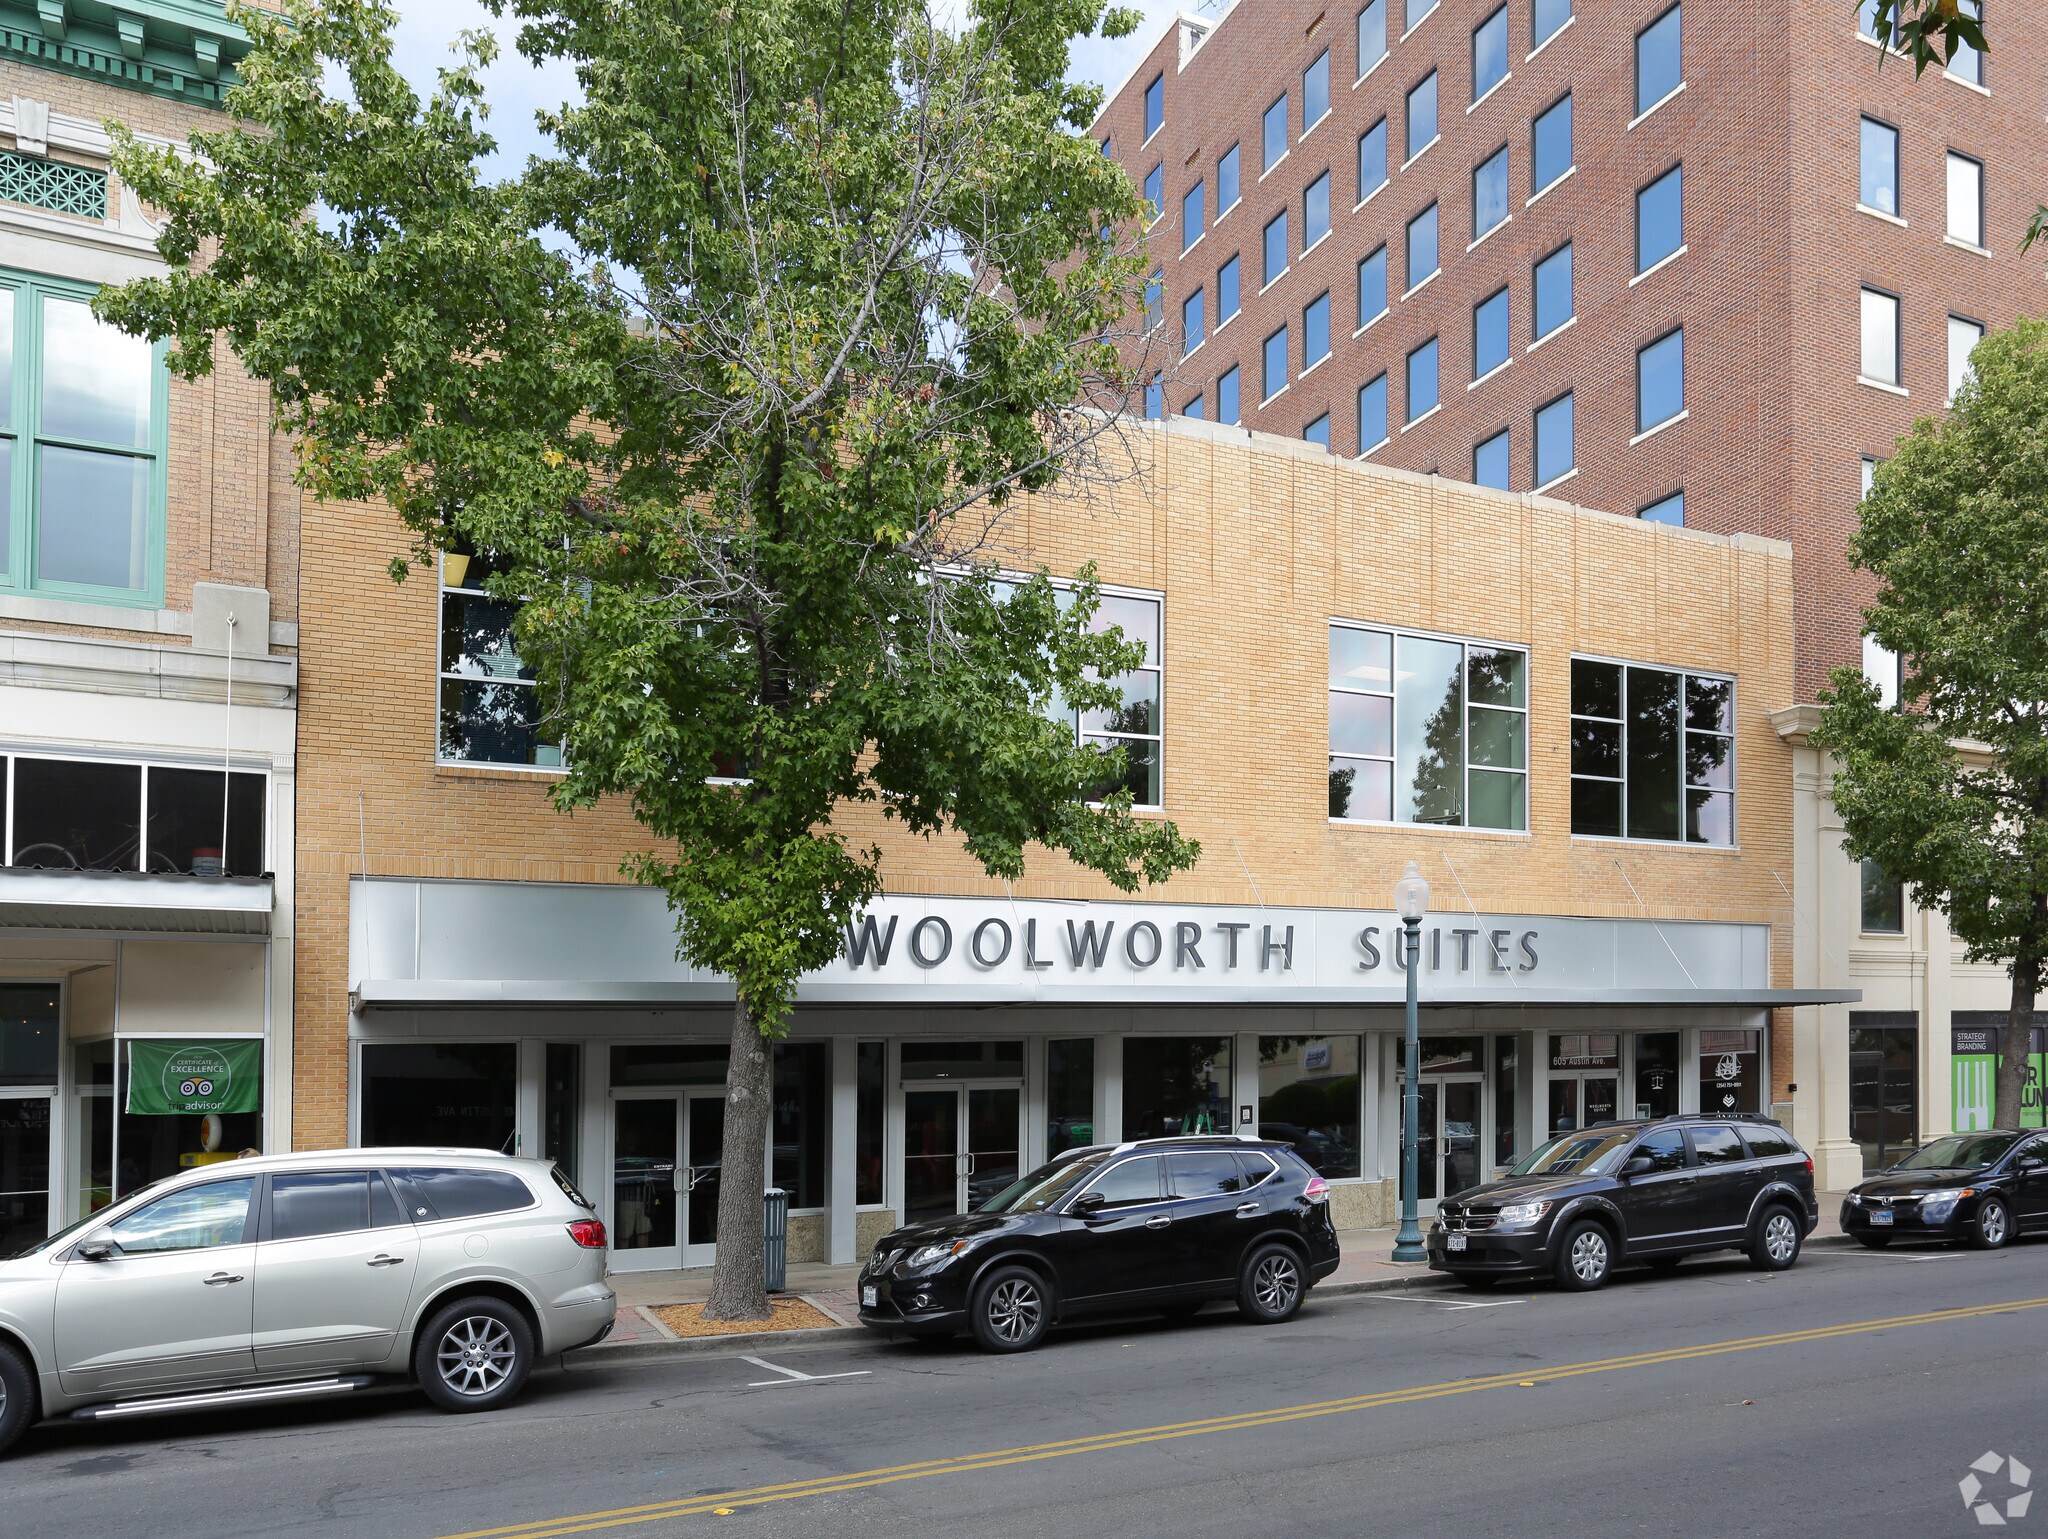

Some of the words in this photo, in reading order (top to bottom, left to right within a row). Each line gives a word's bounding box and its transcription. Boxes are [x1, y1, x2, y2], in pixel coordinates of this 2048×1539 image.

[846, 914, 1292, 971] WOOLWORTH
[1359, 926, 1539, 972] SUITES
[1957, 1032, 1986, 1040] STRATEGY
[1957, 1042, 1987, 1050] BRANDING
[1553, 1056, 1567, 1066] 605
[1568, 1056, 1590, 1065] Austin
[1591, 1056, 1606, 1065] Ave.
[170, 1065, 224, 1073] EXCELLENCE
[168, 1101, 222, 1112] tripadvisor
